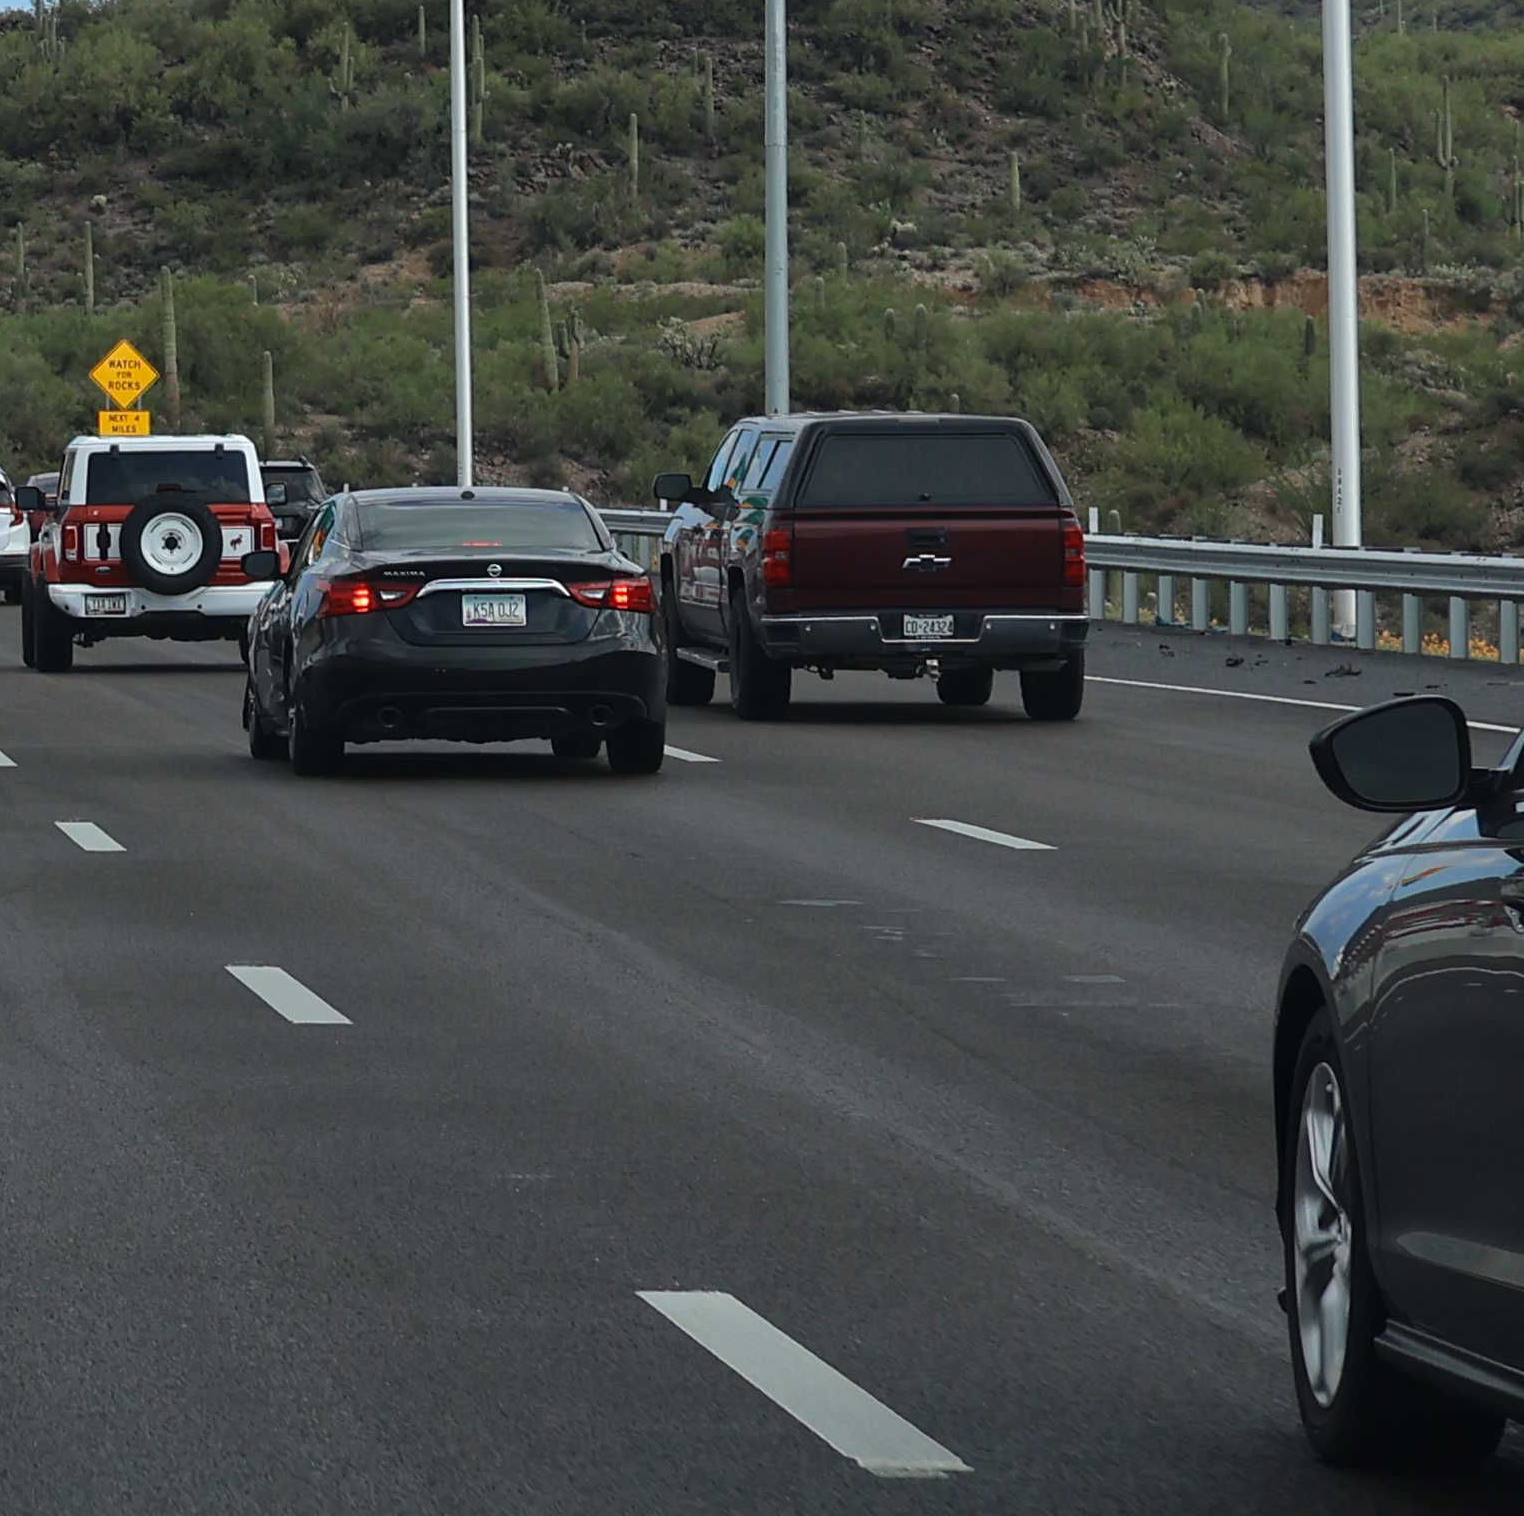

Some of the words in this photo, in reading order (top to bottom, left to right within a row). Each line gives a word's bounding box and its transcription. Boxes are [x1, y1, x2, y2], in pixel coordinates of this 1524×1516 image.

[109, 360, 141, 369] WATCH
[108, 381, 141, 390] ROCKS
[109, 414, 128, 422] NEXT
[111, 425, 137, 433] MILES
